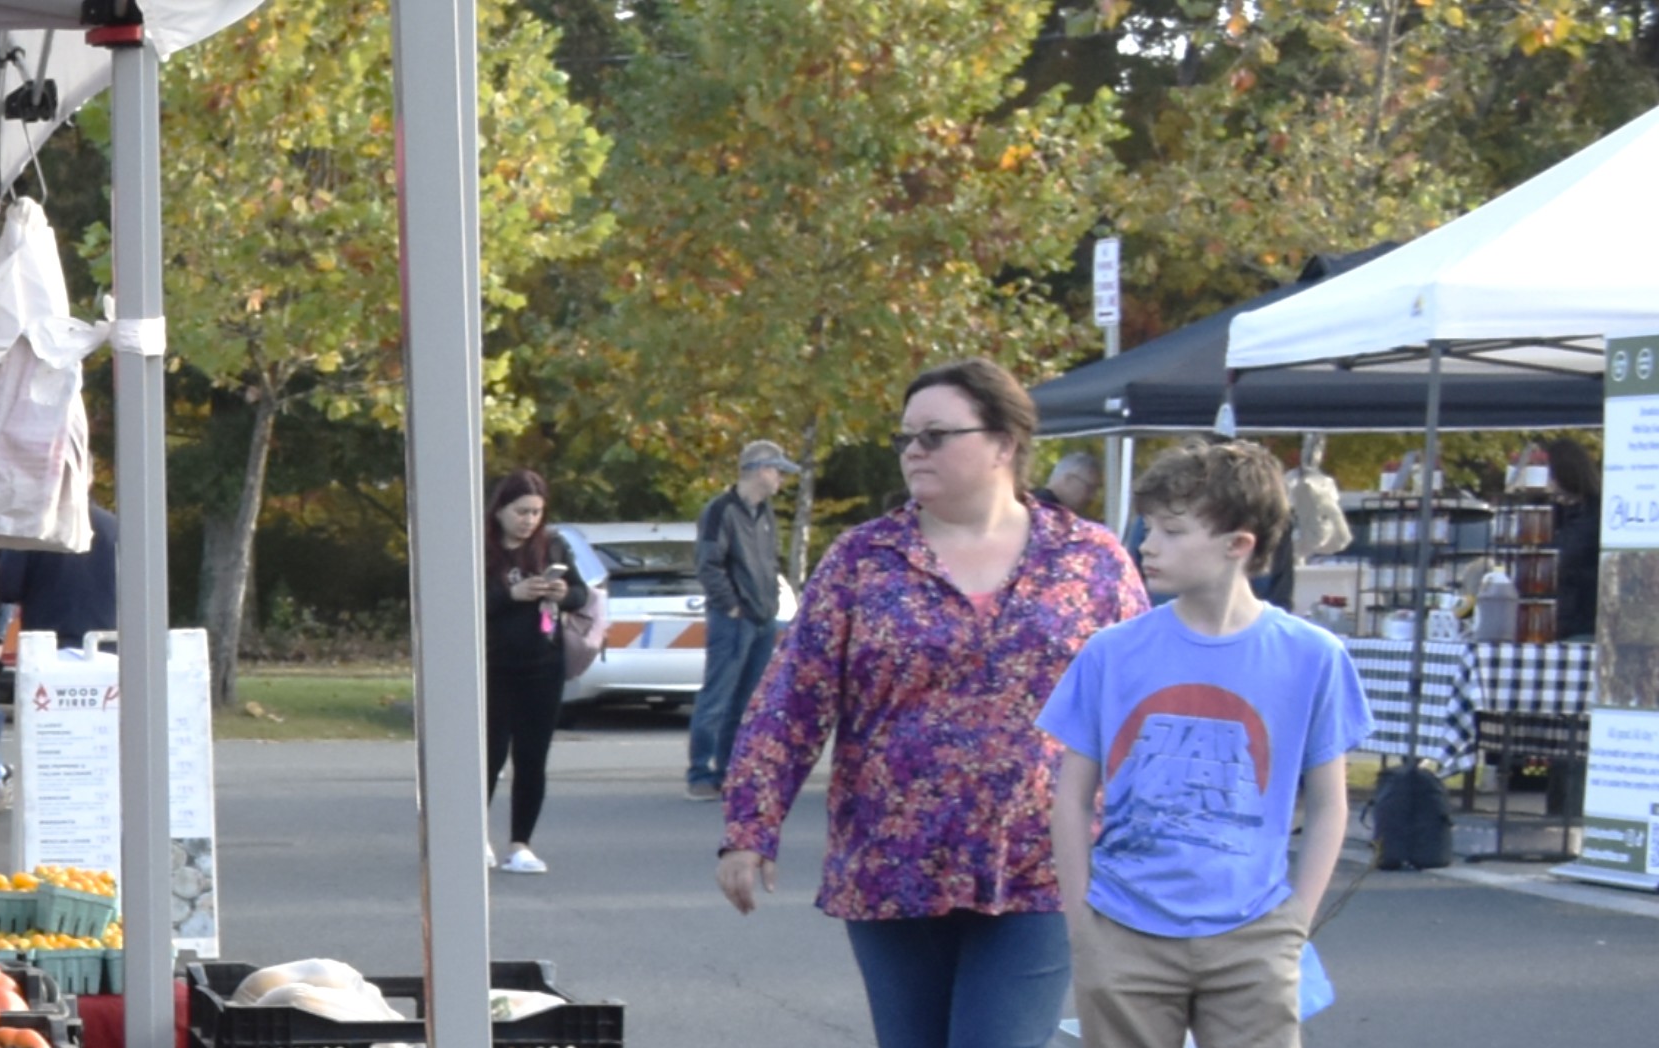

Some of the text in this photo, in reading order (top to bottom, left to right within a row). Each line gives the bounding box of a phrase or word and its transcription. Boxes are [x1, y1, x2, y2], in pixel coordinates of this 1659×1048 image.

[56, 688, 99, 697] WOOD
[58, 698, 98, 707] FIRED
[1129, 713, 1255, 763] STAR
